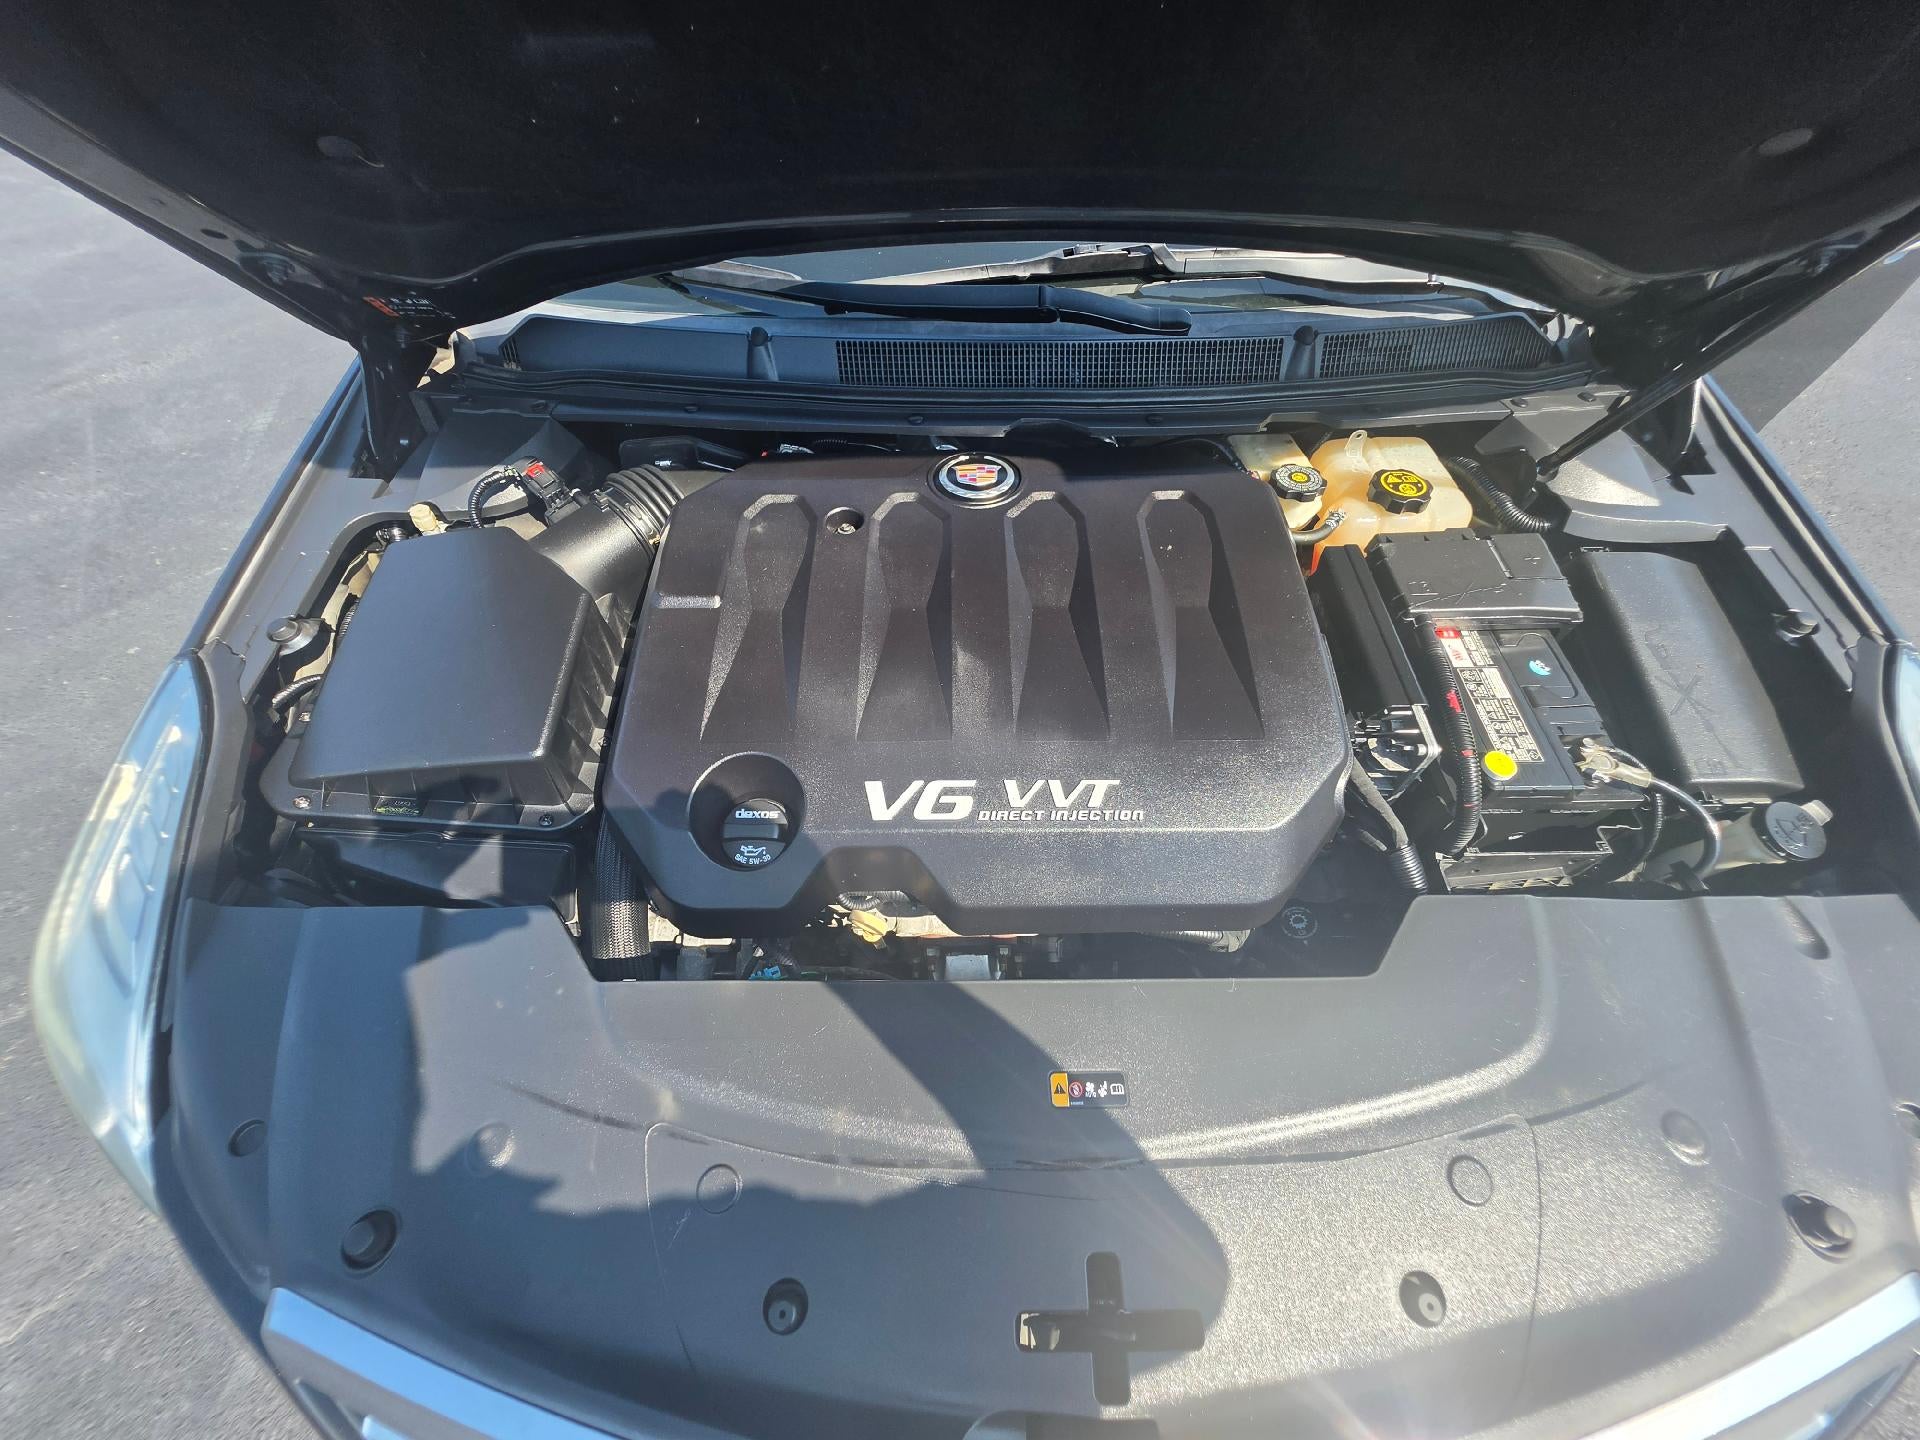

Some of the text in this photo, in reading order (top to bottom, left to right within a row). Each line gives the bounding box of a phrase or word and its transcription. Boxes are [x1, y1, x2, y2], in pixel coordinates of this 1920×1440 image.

[864, 780, 1121, 821] V6 VVT
[735, 808, 780, 819] dexos
[977, 810, 1144, 821] DIRECT INJECTION
[734, 853, 771, 865] SAE 5W-30
